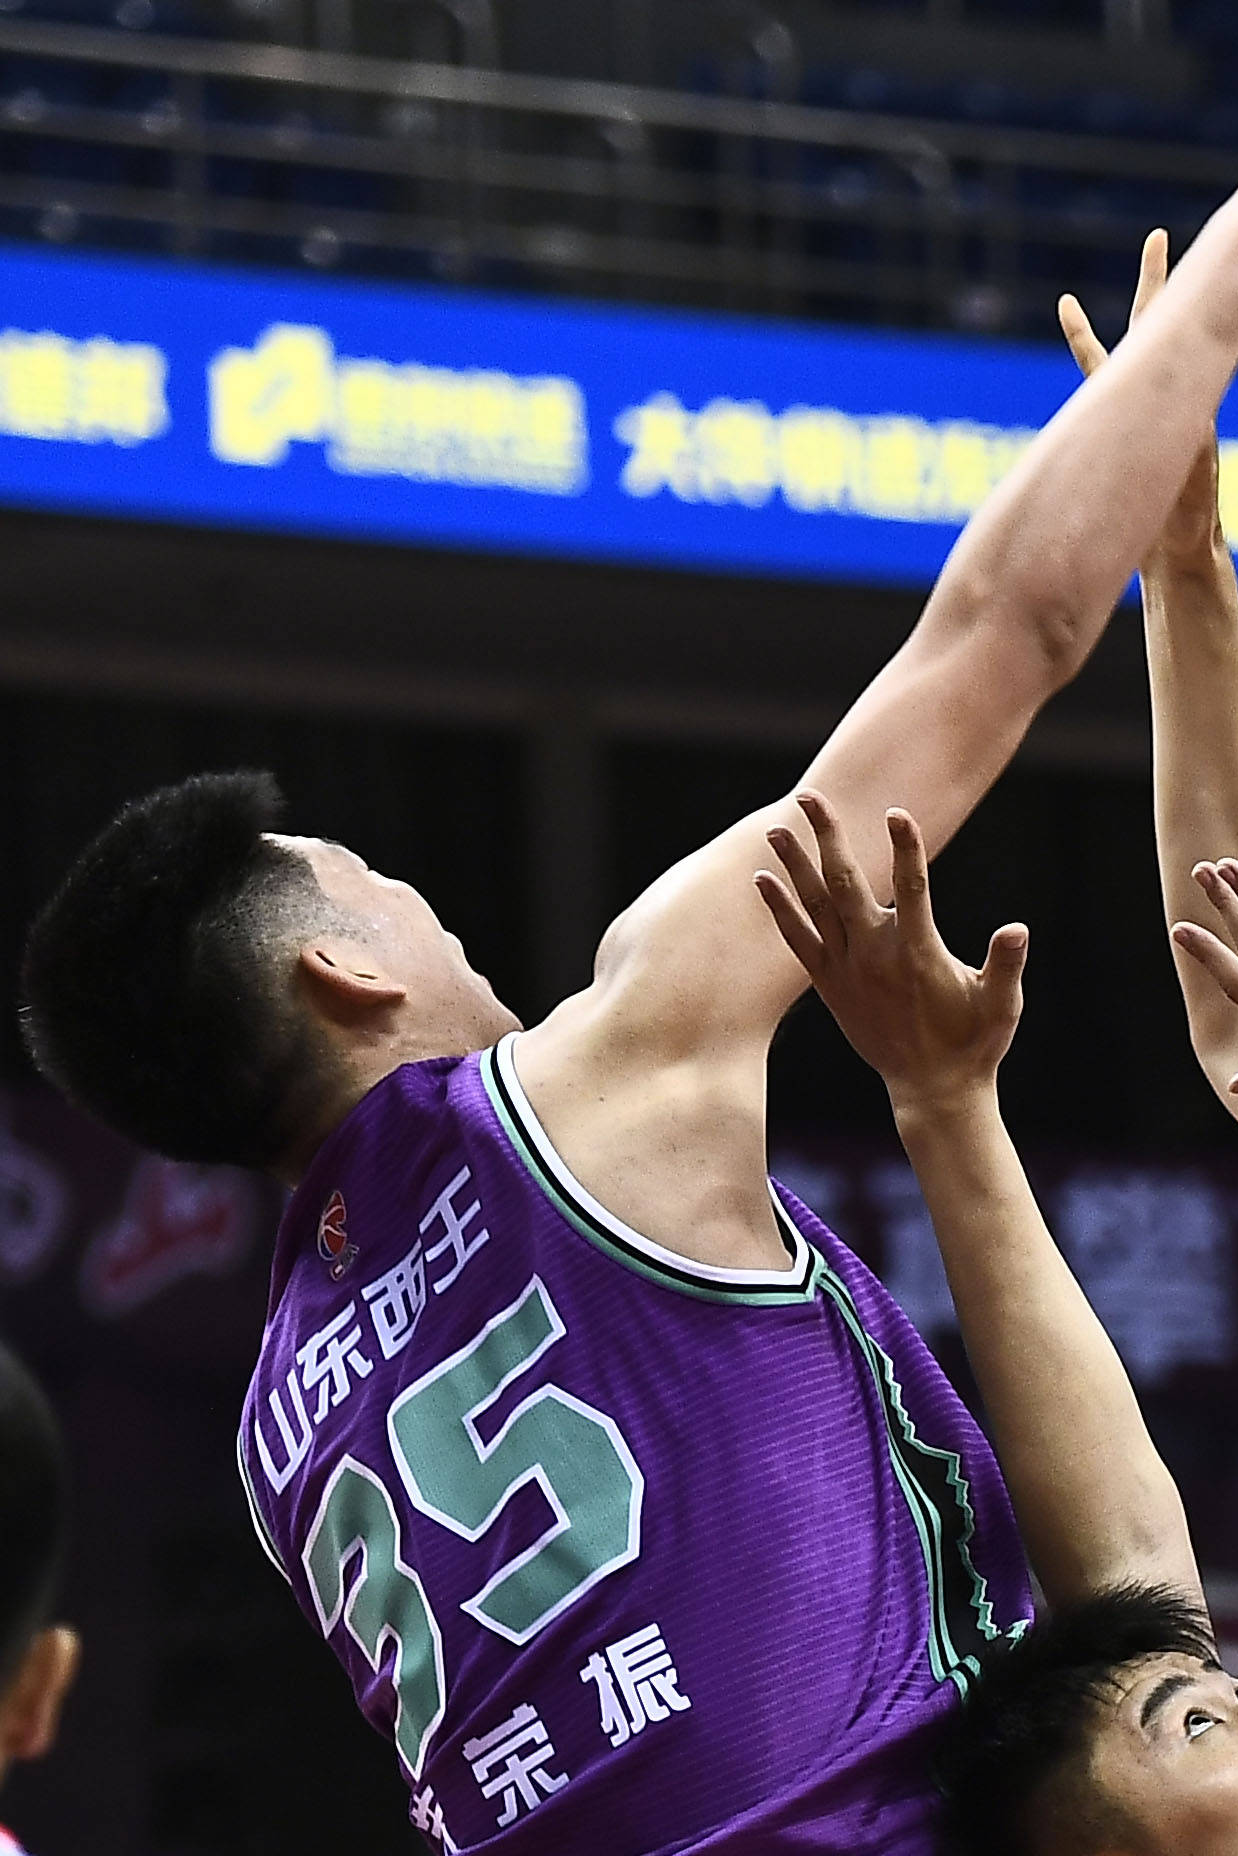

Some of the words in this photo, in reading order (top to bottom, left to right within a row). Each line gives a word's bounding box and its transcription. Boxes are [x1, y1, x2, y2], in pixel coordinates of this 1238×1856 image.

[255, 1165, 491, 1495] 山东西王
[302, 1272, 645, 1782] 35
